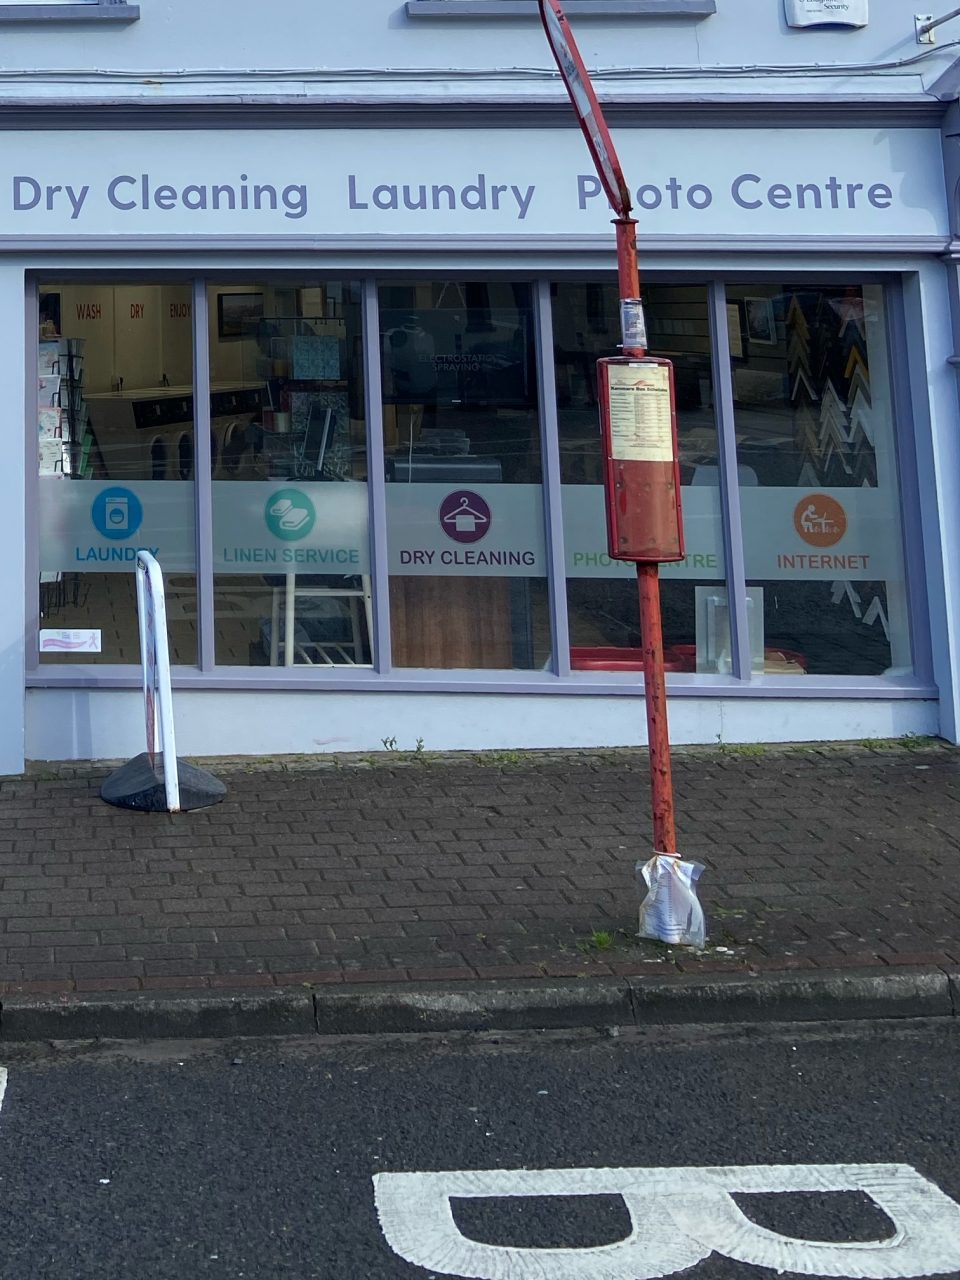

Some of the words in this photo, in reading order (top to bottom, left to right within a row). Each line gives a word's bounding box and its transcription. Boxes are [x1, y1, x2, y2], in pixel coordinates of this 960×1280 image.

[12, 175, 90, 220] Dry
[107, 174, 308, 220] Cleaning
[347, 173, 536, 220] Laundry
[576, 174, 713, 210] Poto
[731, 173, 893, 210] Centre
[76, 303, 101, 320] WASH
[130, 303, 144, 319] DRY
[169, 303, 191, 318] ENJOY
[431, 362, 480, 371] SPRAYING
[76, 547, 160, 561] LAUNDY
[223, 547, 277, 563] LINEN
[282, 548, 360, 563] SERVICE
[400, 550, 436, 565] DRY
[440, 550, 536, 566] CLEANING
[650, 553, 717, 568] TRE
[777, 554, 870, 570] INTERNET
